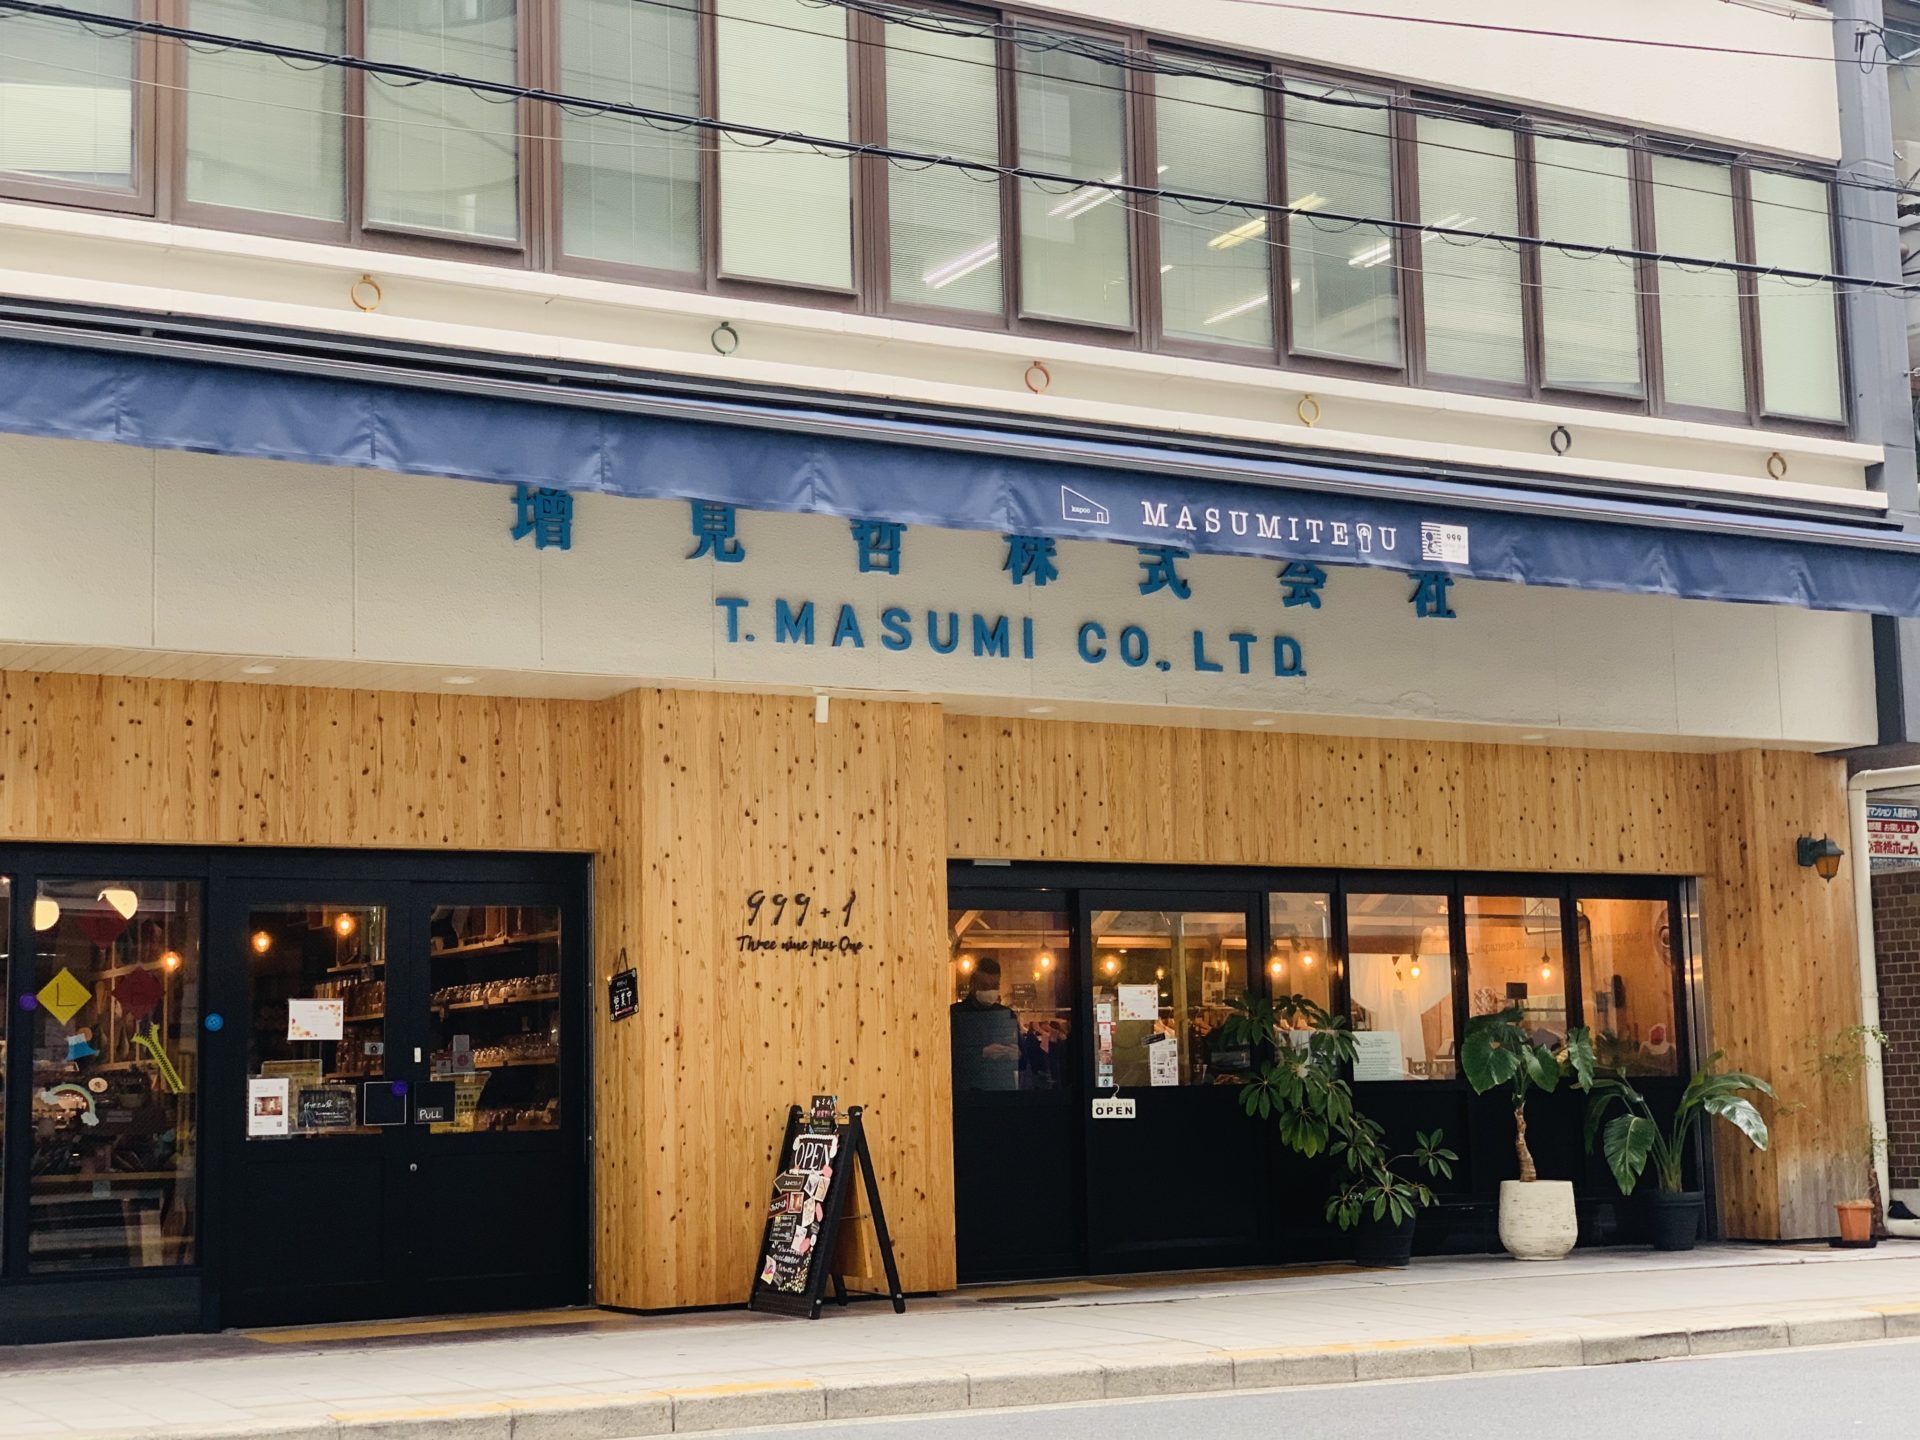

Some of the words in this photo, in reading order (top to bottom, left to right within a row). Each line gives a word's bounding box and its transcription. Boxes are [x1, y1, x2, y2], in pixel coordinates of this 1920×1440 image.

[736, 935, 777, 952] Three
[810, 938, 838, 957] plus
[420, 1109, 441, 1119] PULL
[1095, 1106, 1133, 1115] OPEN
[795, 1142, 830, 1169] OPEN
